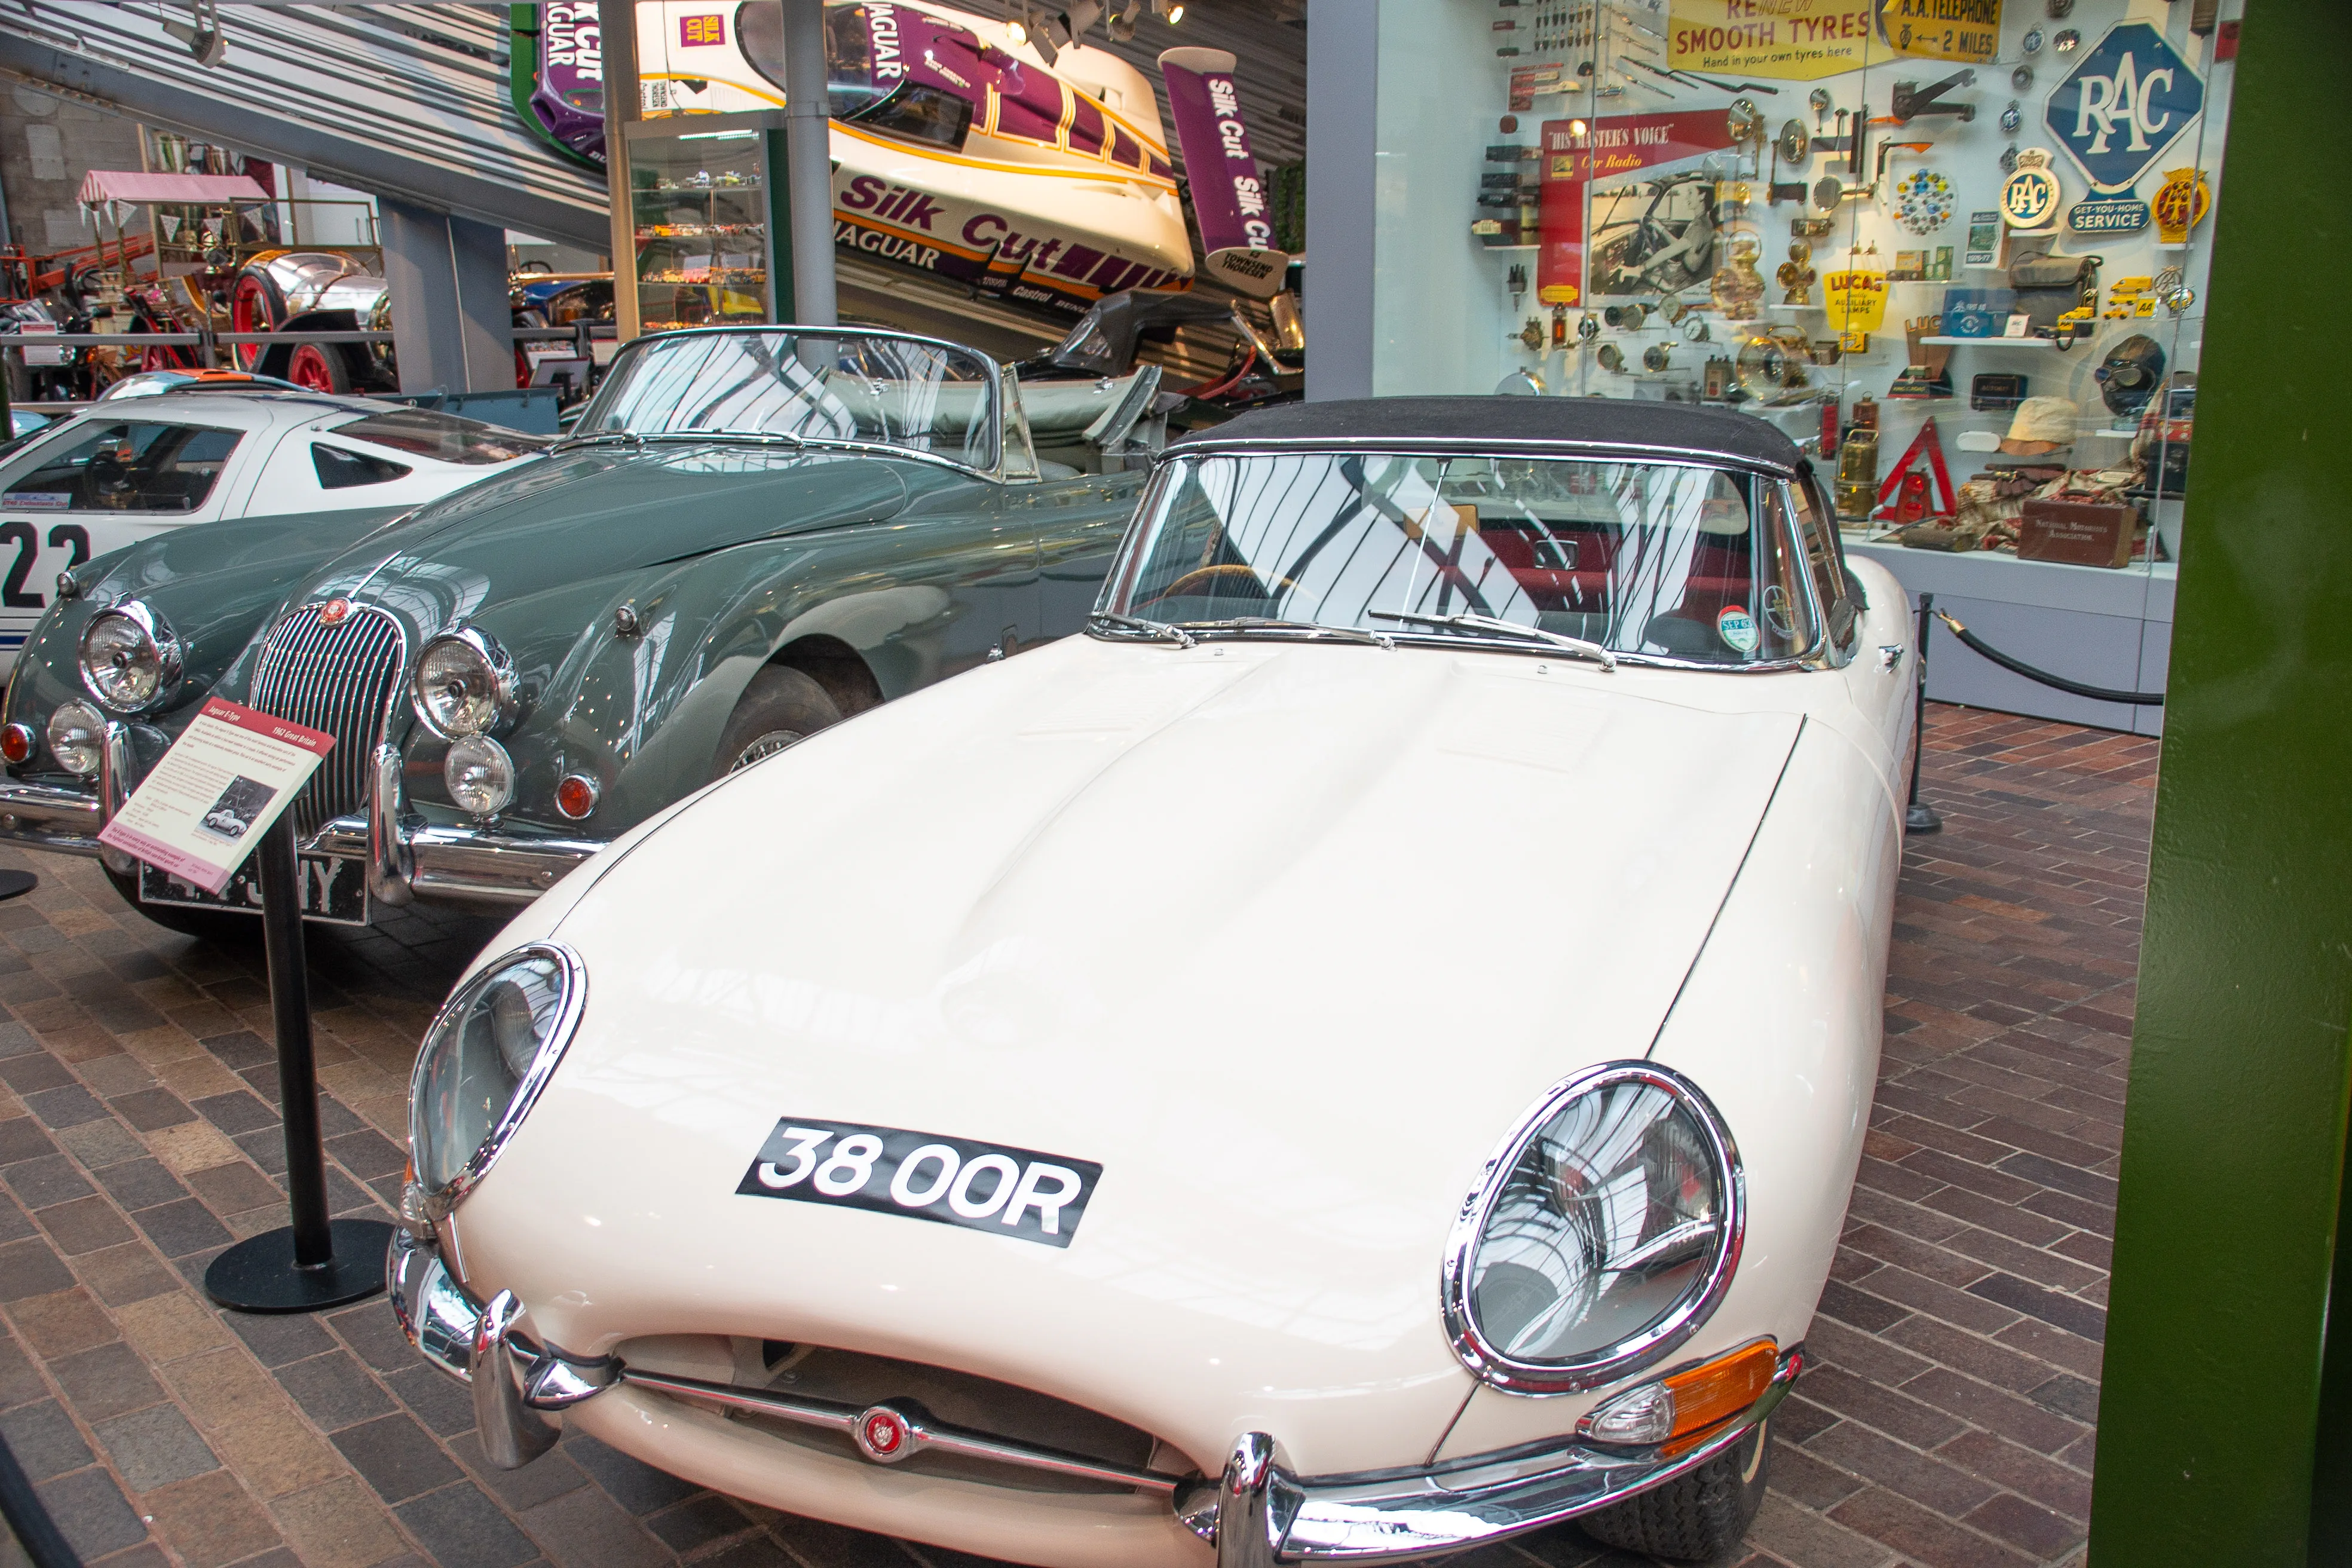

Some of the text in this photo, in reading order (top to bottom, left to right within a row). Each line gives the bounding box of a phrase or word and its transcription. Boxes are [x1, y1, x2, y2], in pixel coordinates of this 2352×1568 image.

[687, 19, 703, 42] CUT
[703, 16, 720, 43] SILK
[1676, 11, 1870, 54] SMOOTH TYRES
[574, 26, 603, 82] Cut
[1943, 30, 1994, 55] 2 MILES
[1703, 45, 1852, 68] Hand in your own tyres here
[2072, 51, 2175, 154] RAC
[1208, 78, 1249, 160] Silk Cut
[1605, 153, 1643, 169] Radio
[841, 174, 947, 231] Silk
[2008, 174, 2047, 214] RAC
[1234, 175, 1271, 252] Silk Cu
[2075, 203, 2144, 215] GET-YOU-HOME
[2075, 213, 2142, 229] SERVICE
[962, 213, 1062, 270] Cut
[1012, 286, 1054, 303] Castrol
[1831, 274, 1883, 292] LUCAS
[2137, 302, 2154, 312] AA
[1904, 315, 1941, 333] LUC
[1722, 619, 1753, 630] SEP 63
[209, 705, 241, 722] Jaguar E-Type
[272, 725, 317, 747] 1962 Great Britain
[758, 1126, 884, 1196] 38
